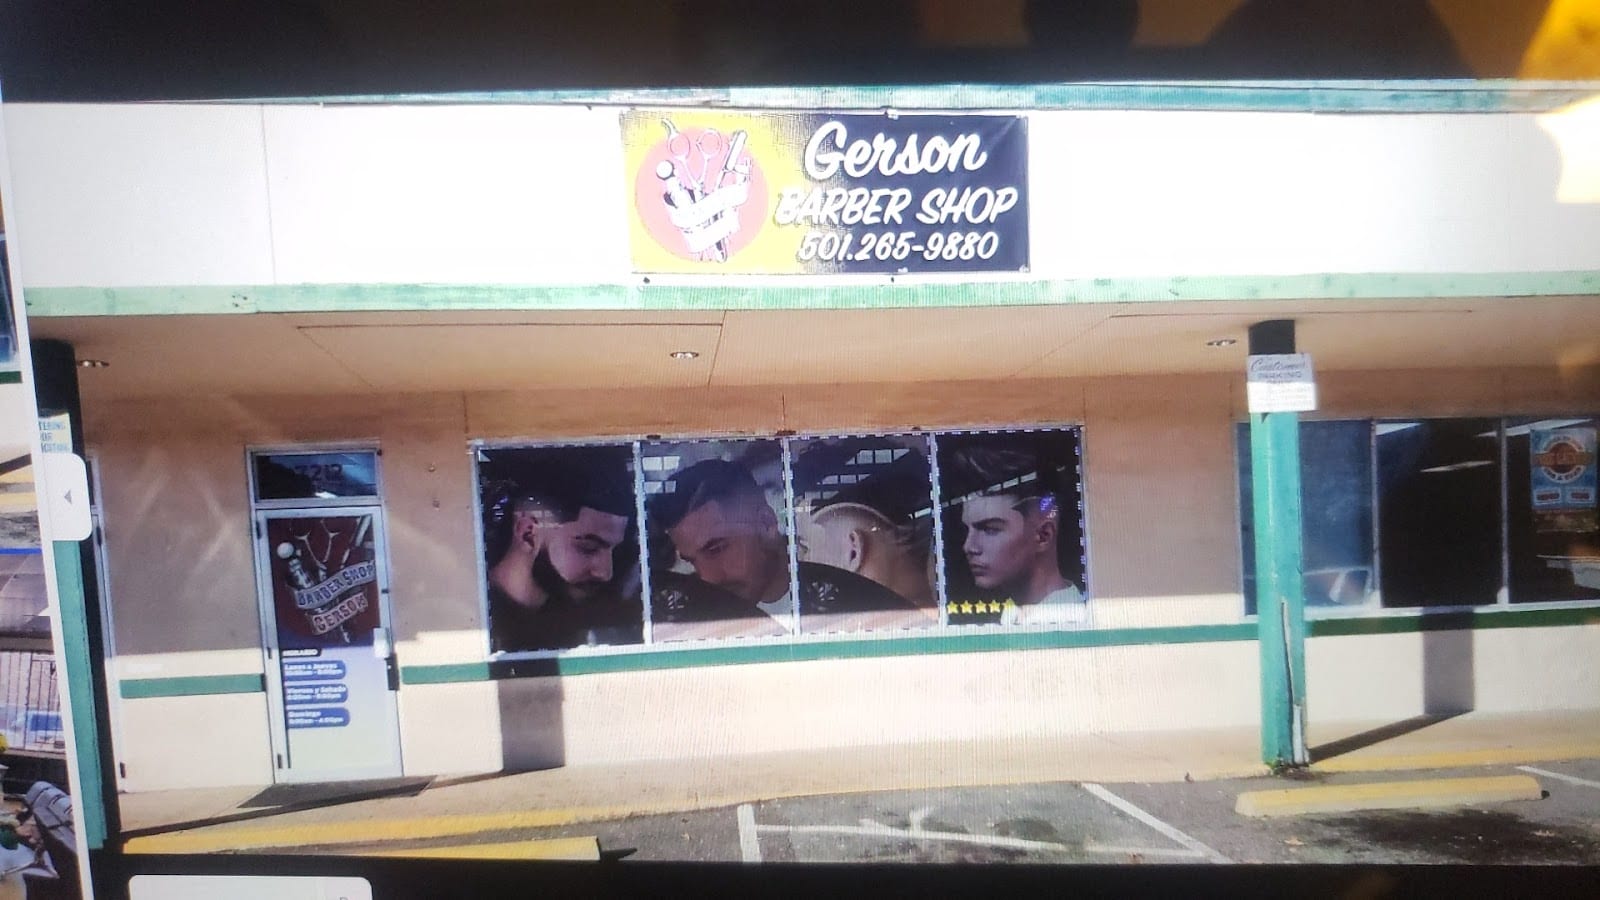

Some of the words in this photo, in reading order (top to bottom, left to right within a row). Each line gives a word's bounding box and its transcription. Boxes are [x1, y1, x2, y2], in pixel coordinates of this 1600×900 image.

[803, 120, 989, 180] Gerson
[774, 188, 912, 226] BARBER
[915, 187, 1019, 225] SHOP
[799, 231, 999, 263] 501.265-9880
[297, 578, 344, 606] BARBER
[343, 565, 375, 586] SHOP
[314, 595, 367, 631] GERSON
